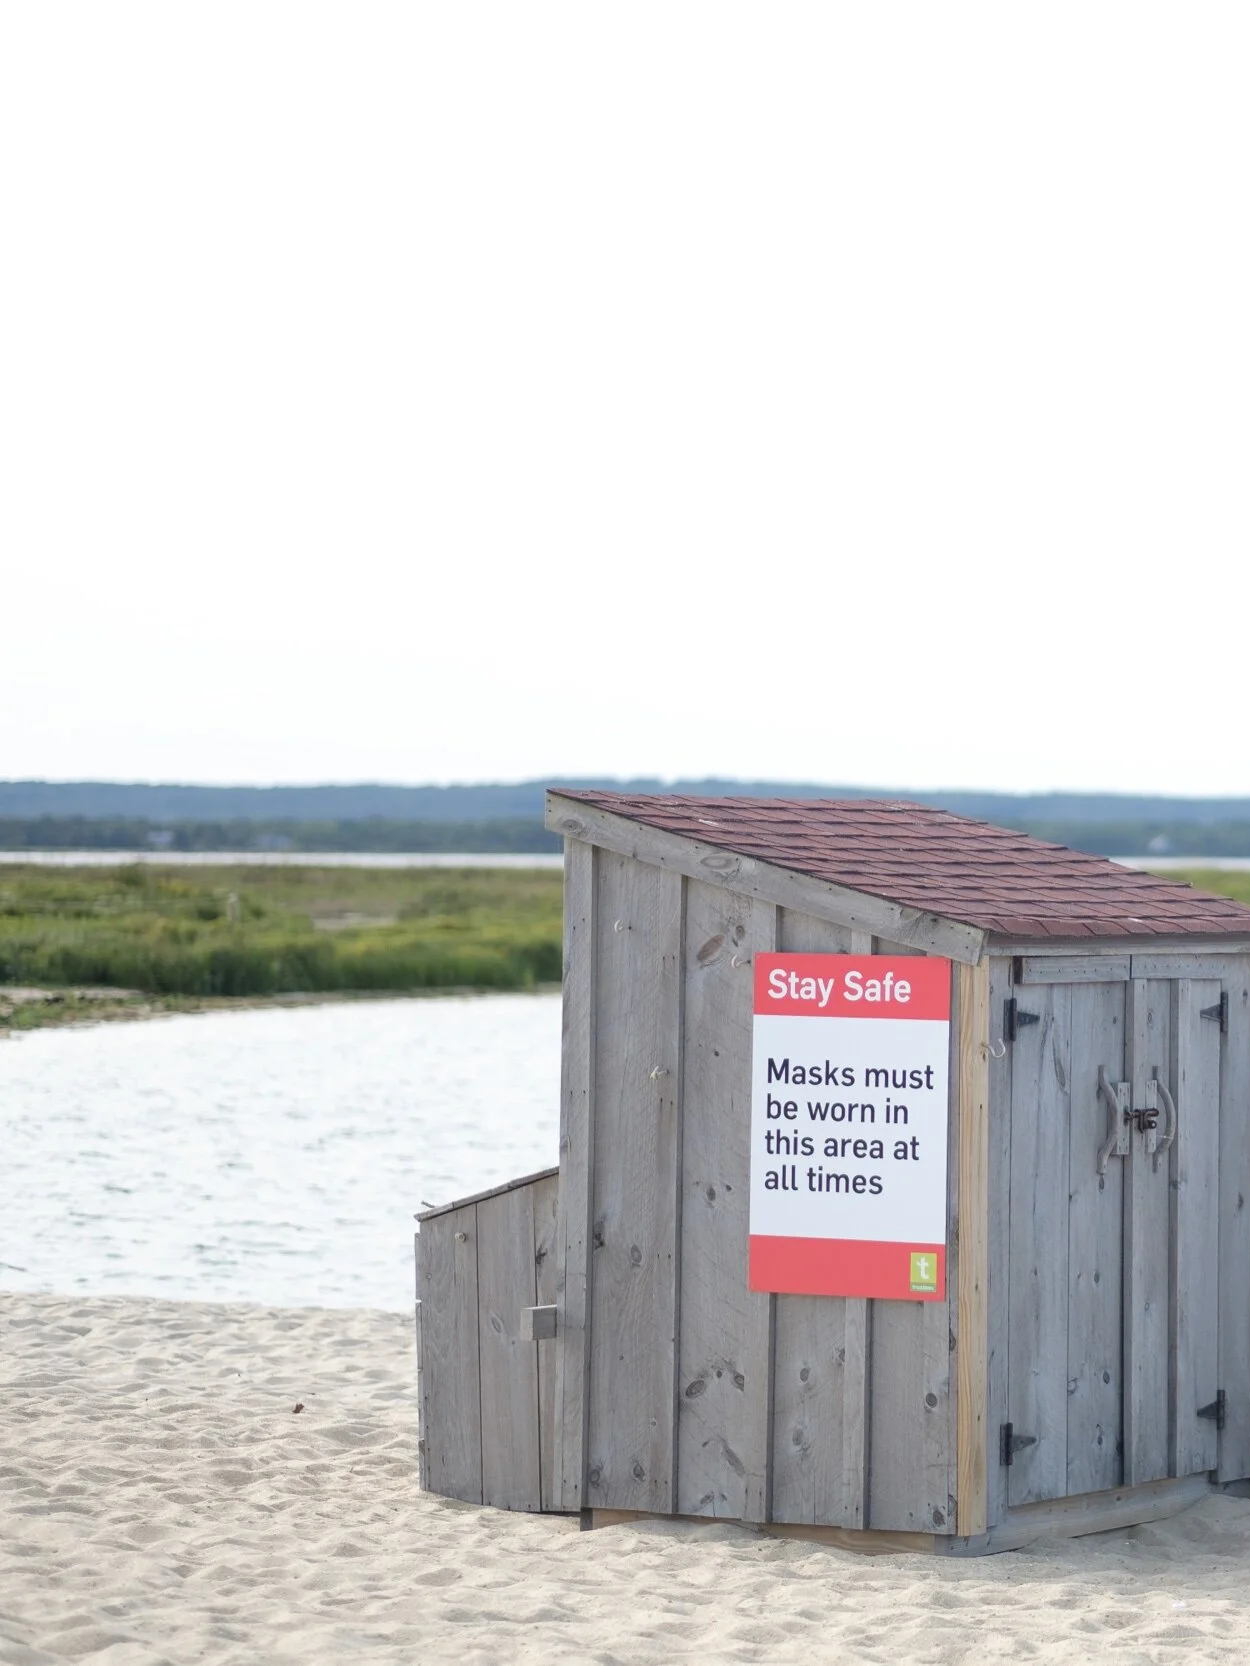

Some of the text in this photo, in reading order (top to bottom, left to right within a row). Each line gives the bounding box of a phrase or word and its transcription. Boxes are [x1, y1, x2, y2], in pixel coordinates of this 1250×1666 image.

[767, 968, 912, 1008] Stay Safe
[767, 1057, 934, 1090] Masks must
[766, 1093, 909, 1125] be worn in
[765, 1129, 920, 1161] this area at
[764, 1164, 883, 1195] all times
[916, 1256, 930, 1280] t
